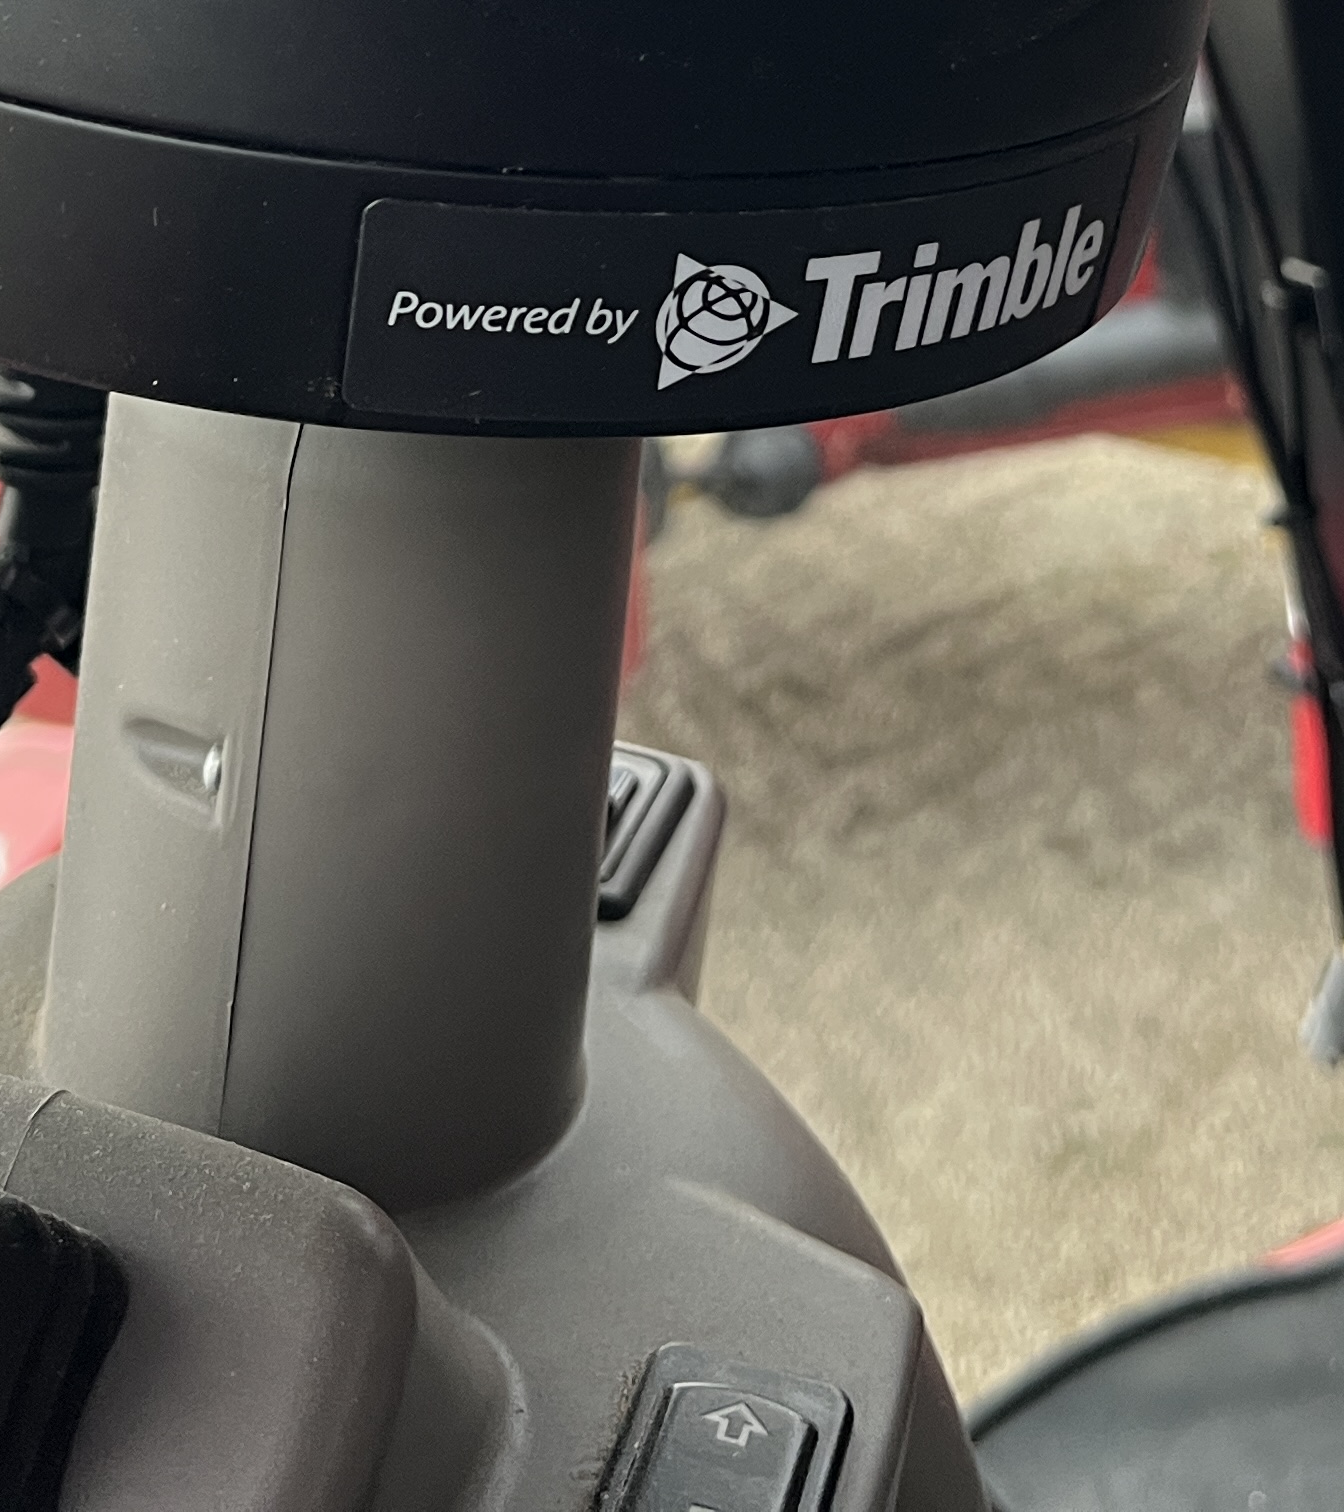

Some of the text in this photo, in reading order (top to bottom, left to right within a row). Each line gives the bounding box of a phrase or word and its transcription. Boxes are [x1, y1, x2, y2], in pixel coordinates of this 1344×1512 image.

[387, 204, 1105, 364] Powered by Trimble
